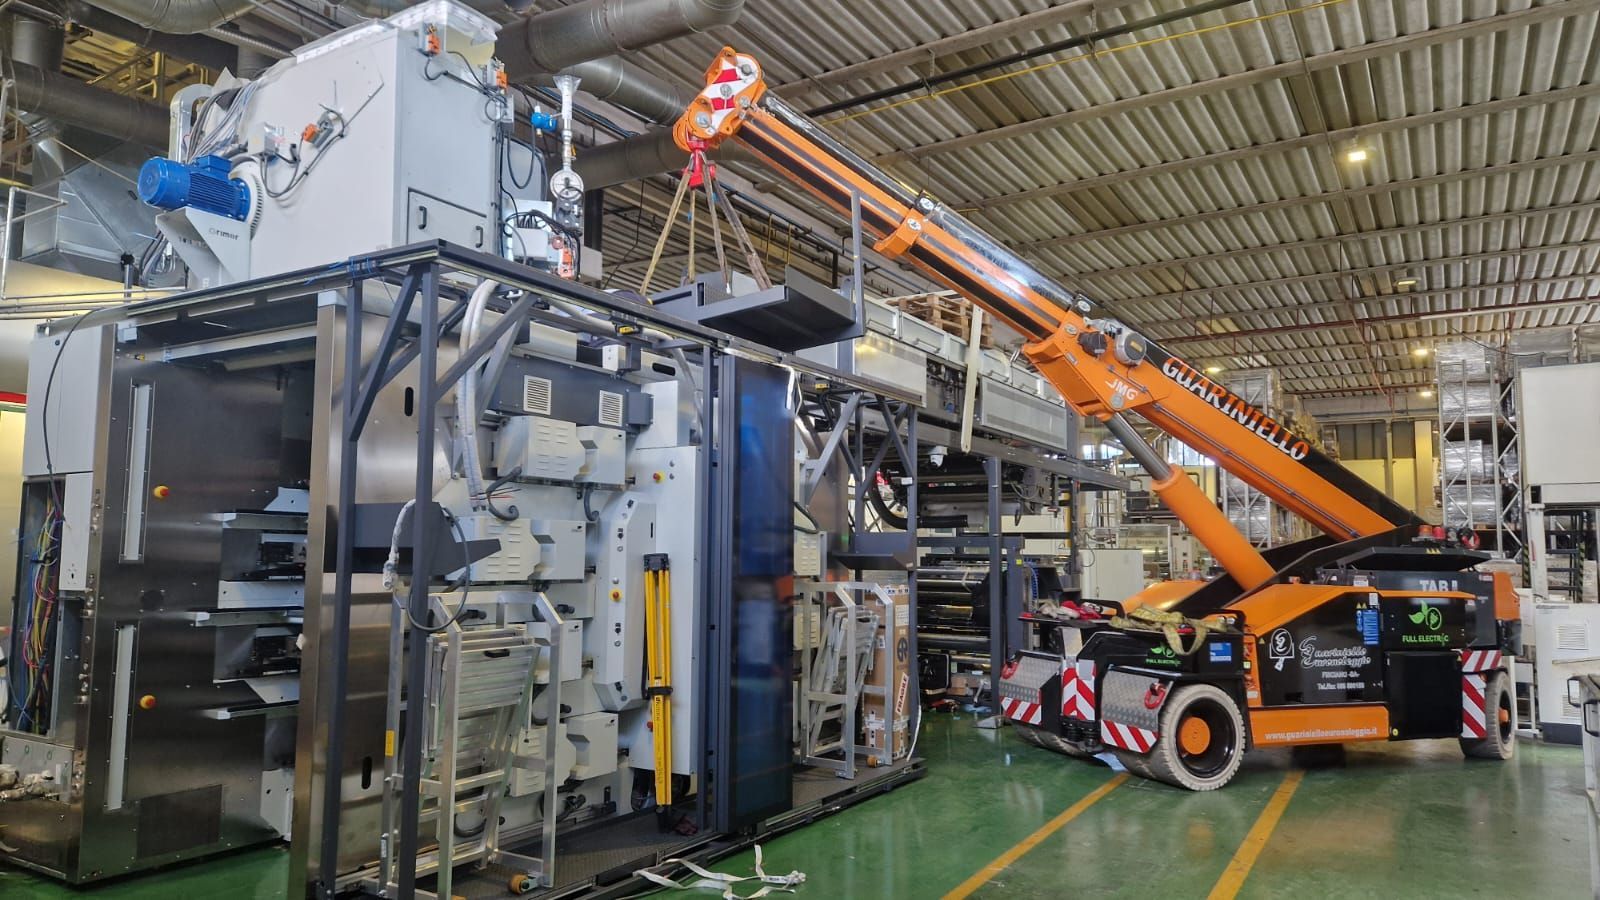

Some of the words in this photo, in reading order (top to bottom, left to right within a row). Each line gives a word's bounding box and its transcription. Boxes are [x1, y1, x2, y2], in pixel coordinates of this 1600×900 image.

[1105, 379, 1138, 400] JMG
[1163, 357, 1310, 460] GUARINIELLO
[1402, 635, 1417, 643] FULL
[897, 676, 908, 713] FRAGILE
